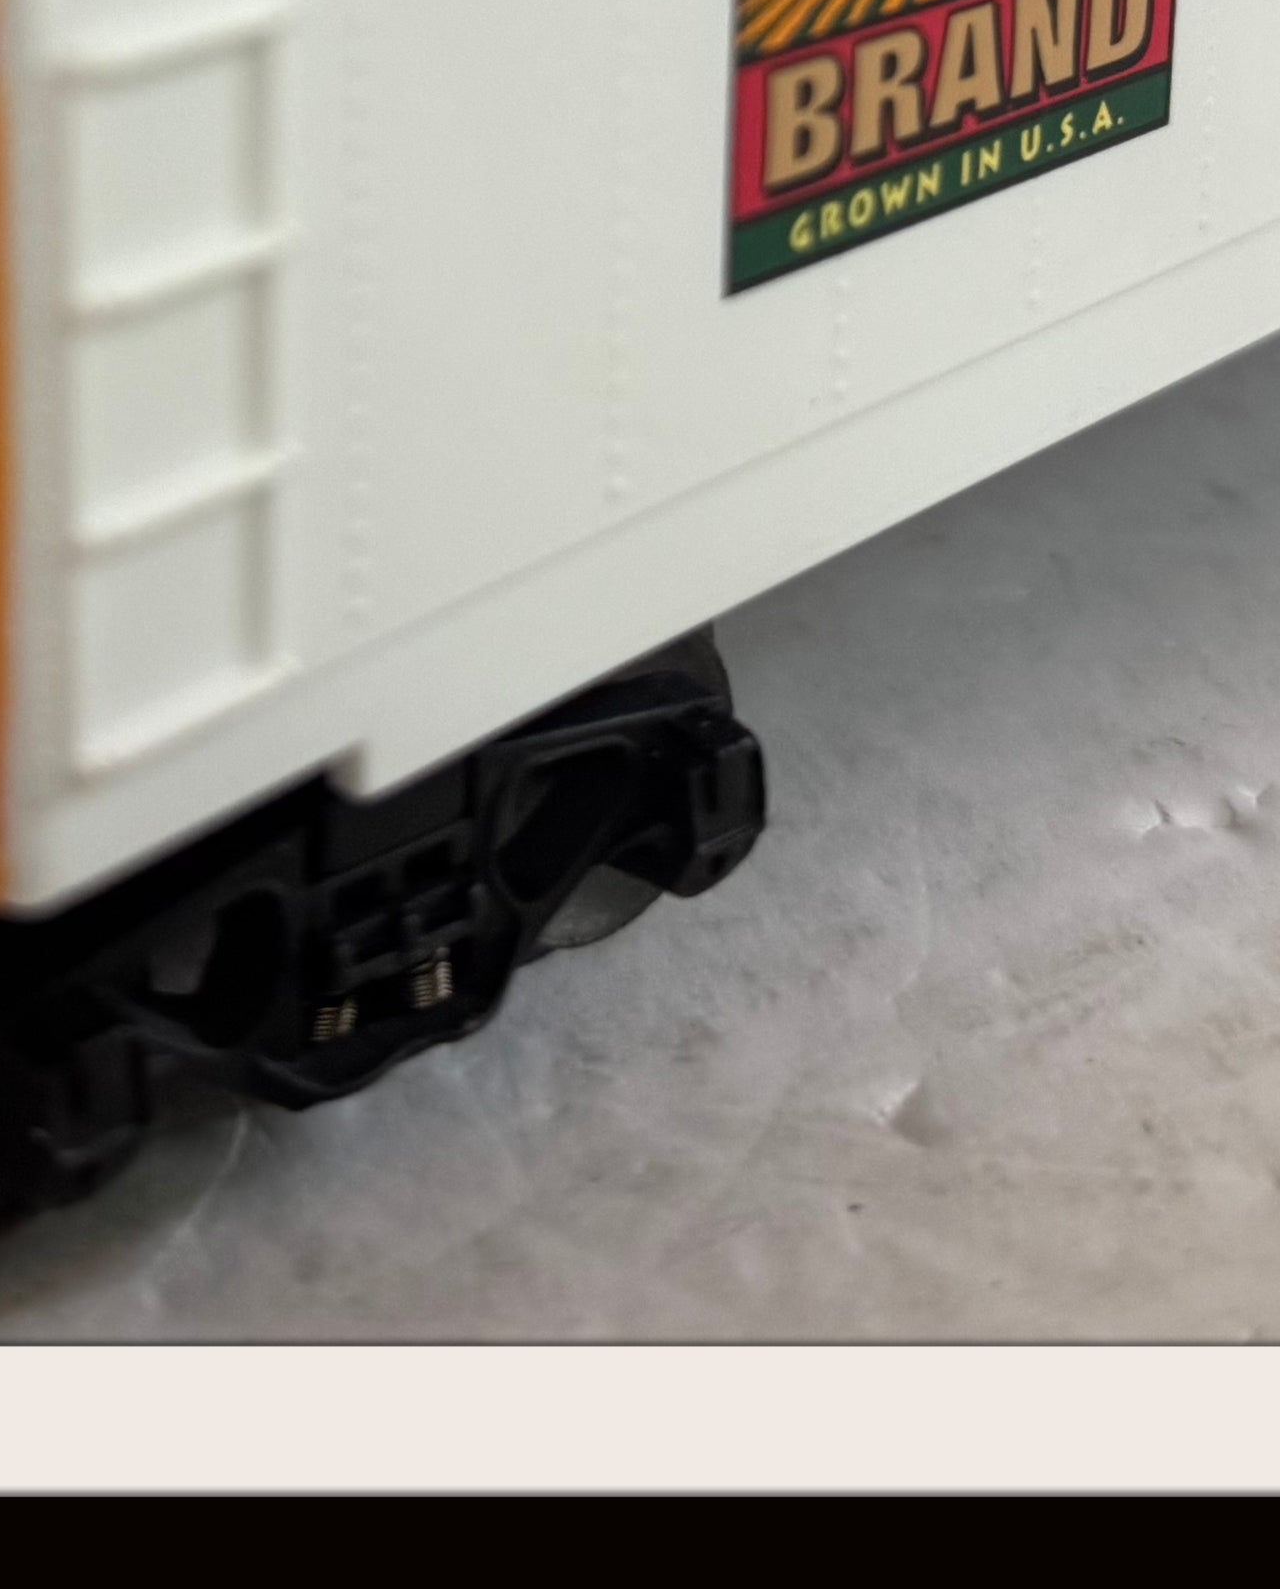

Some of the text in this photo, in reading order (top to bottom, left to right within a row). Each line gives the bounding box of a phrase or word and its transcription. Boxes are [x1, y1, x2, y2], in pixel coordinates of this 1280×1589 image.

[787, 98, 1126, 254] GROWN IN U.S.A.
